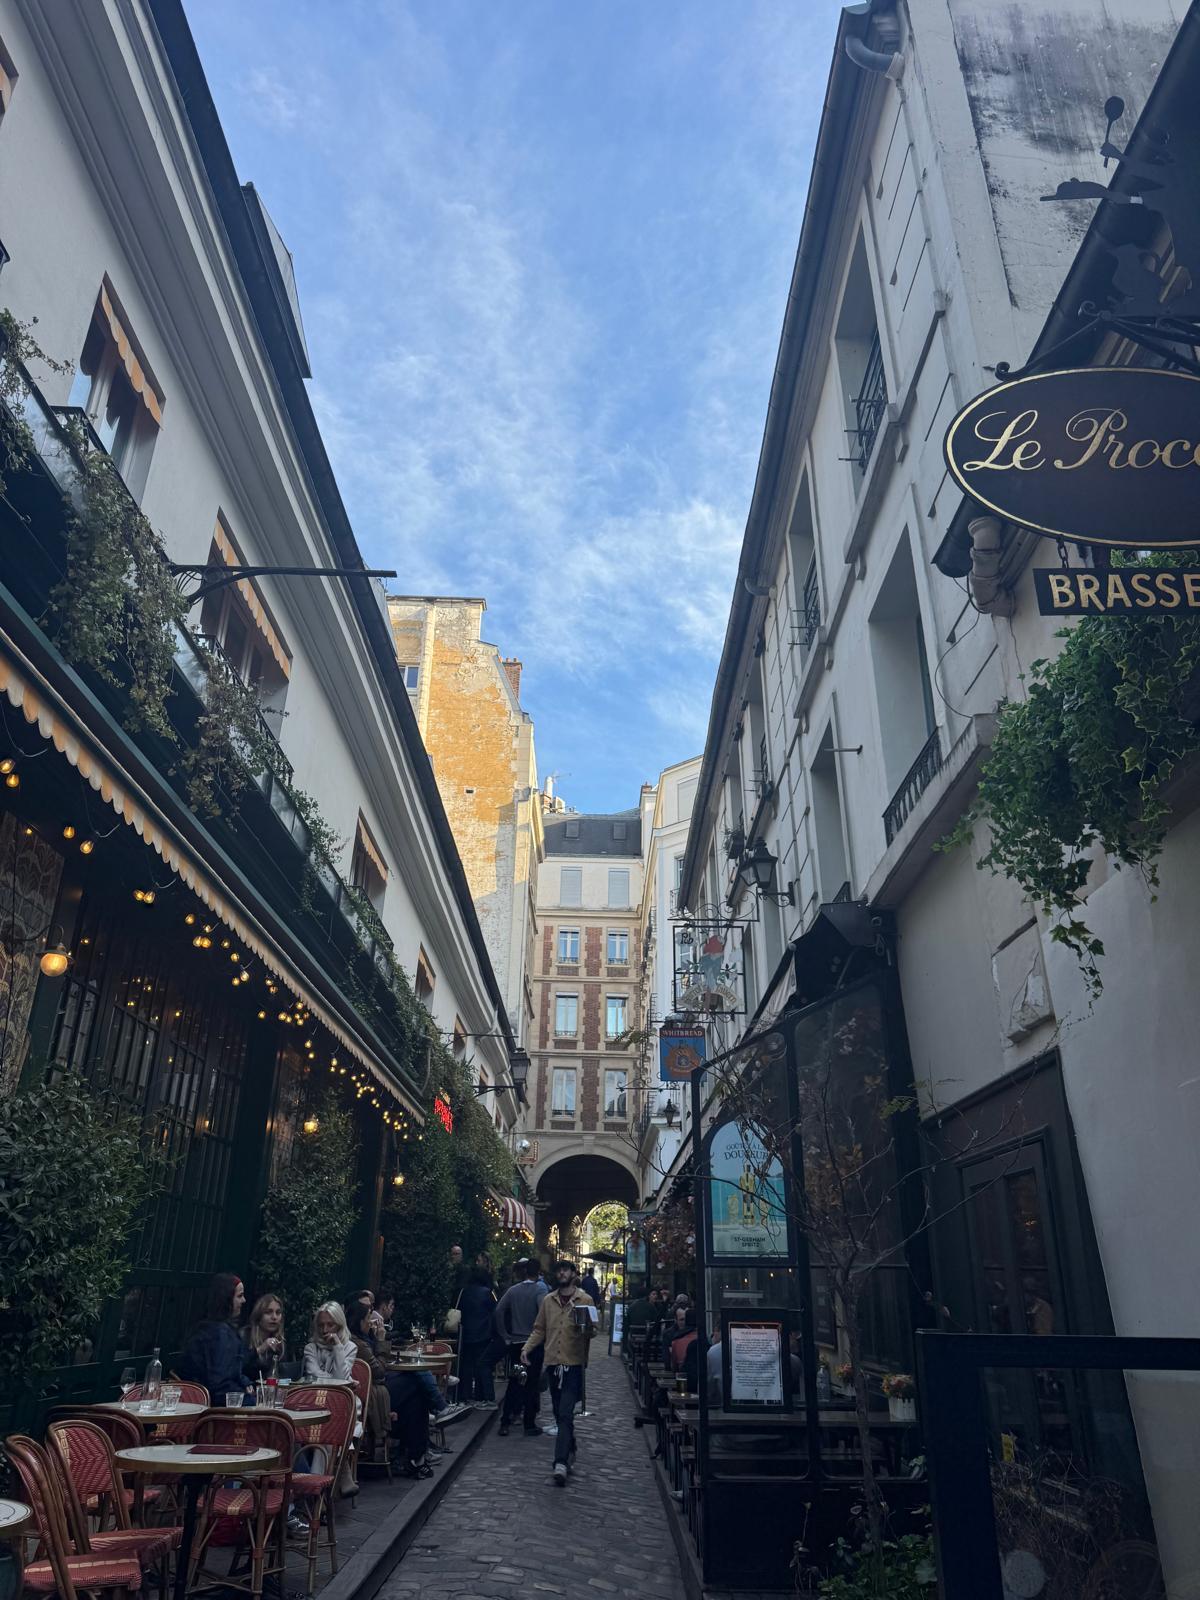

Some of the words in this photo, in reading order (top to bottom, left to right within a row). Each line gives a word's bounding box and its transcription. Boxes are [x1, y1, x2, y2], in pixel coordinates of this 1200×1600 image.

[963, 409, 1046, 471] Le
[1053, 407, 1200, 469] Proc
[1048, 573, 1200, 611] BRASSE
[724, 1150, 768, 1160] DOUEUR
